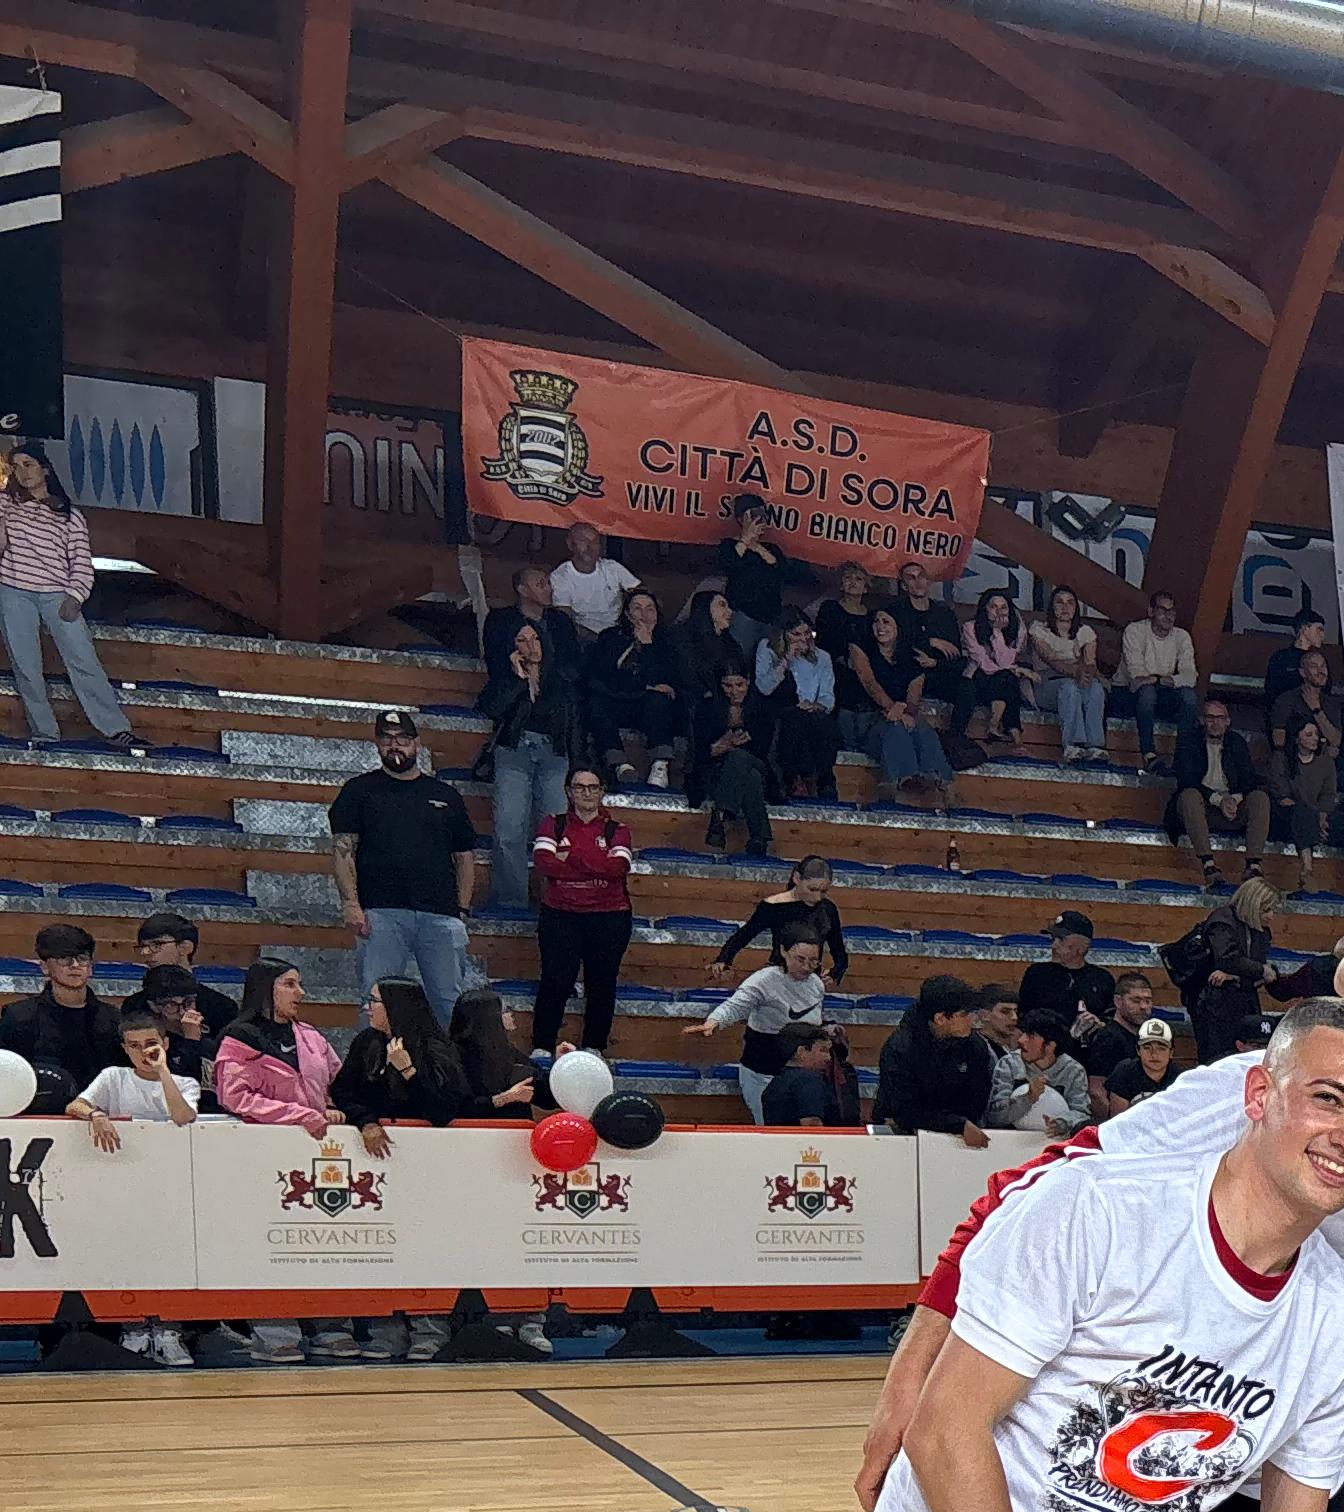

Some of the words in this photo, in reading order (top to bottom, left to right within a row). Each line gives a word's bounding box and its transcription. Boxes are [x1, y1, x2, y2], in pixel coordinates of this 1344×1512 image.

[746, 410, 868, 462] A.S.D.
[638, 438, 771, 491] CITTÀ
[783, 463, 829, 501] DI
[840, 473, 957, 523] SORA
[625, 481, 677, 517] VIVI
[684, 485, 709, 518] IL
[807, 513, 898, 551] BIANCO
[904, 526, 963, 560] NERO
[324, 1189, 343, 1207] C
[574, 1191, 592, 1209] C
[803, 1193, 819, 1210] C
[266, 1228, 397, 1246] CERVANTES
[522, 1229, 641, 1245] CERVANTES
[755, 1229, 865, 1245] CERVANTES
[1136, 1343, 1276, 1421] INTANTO
